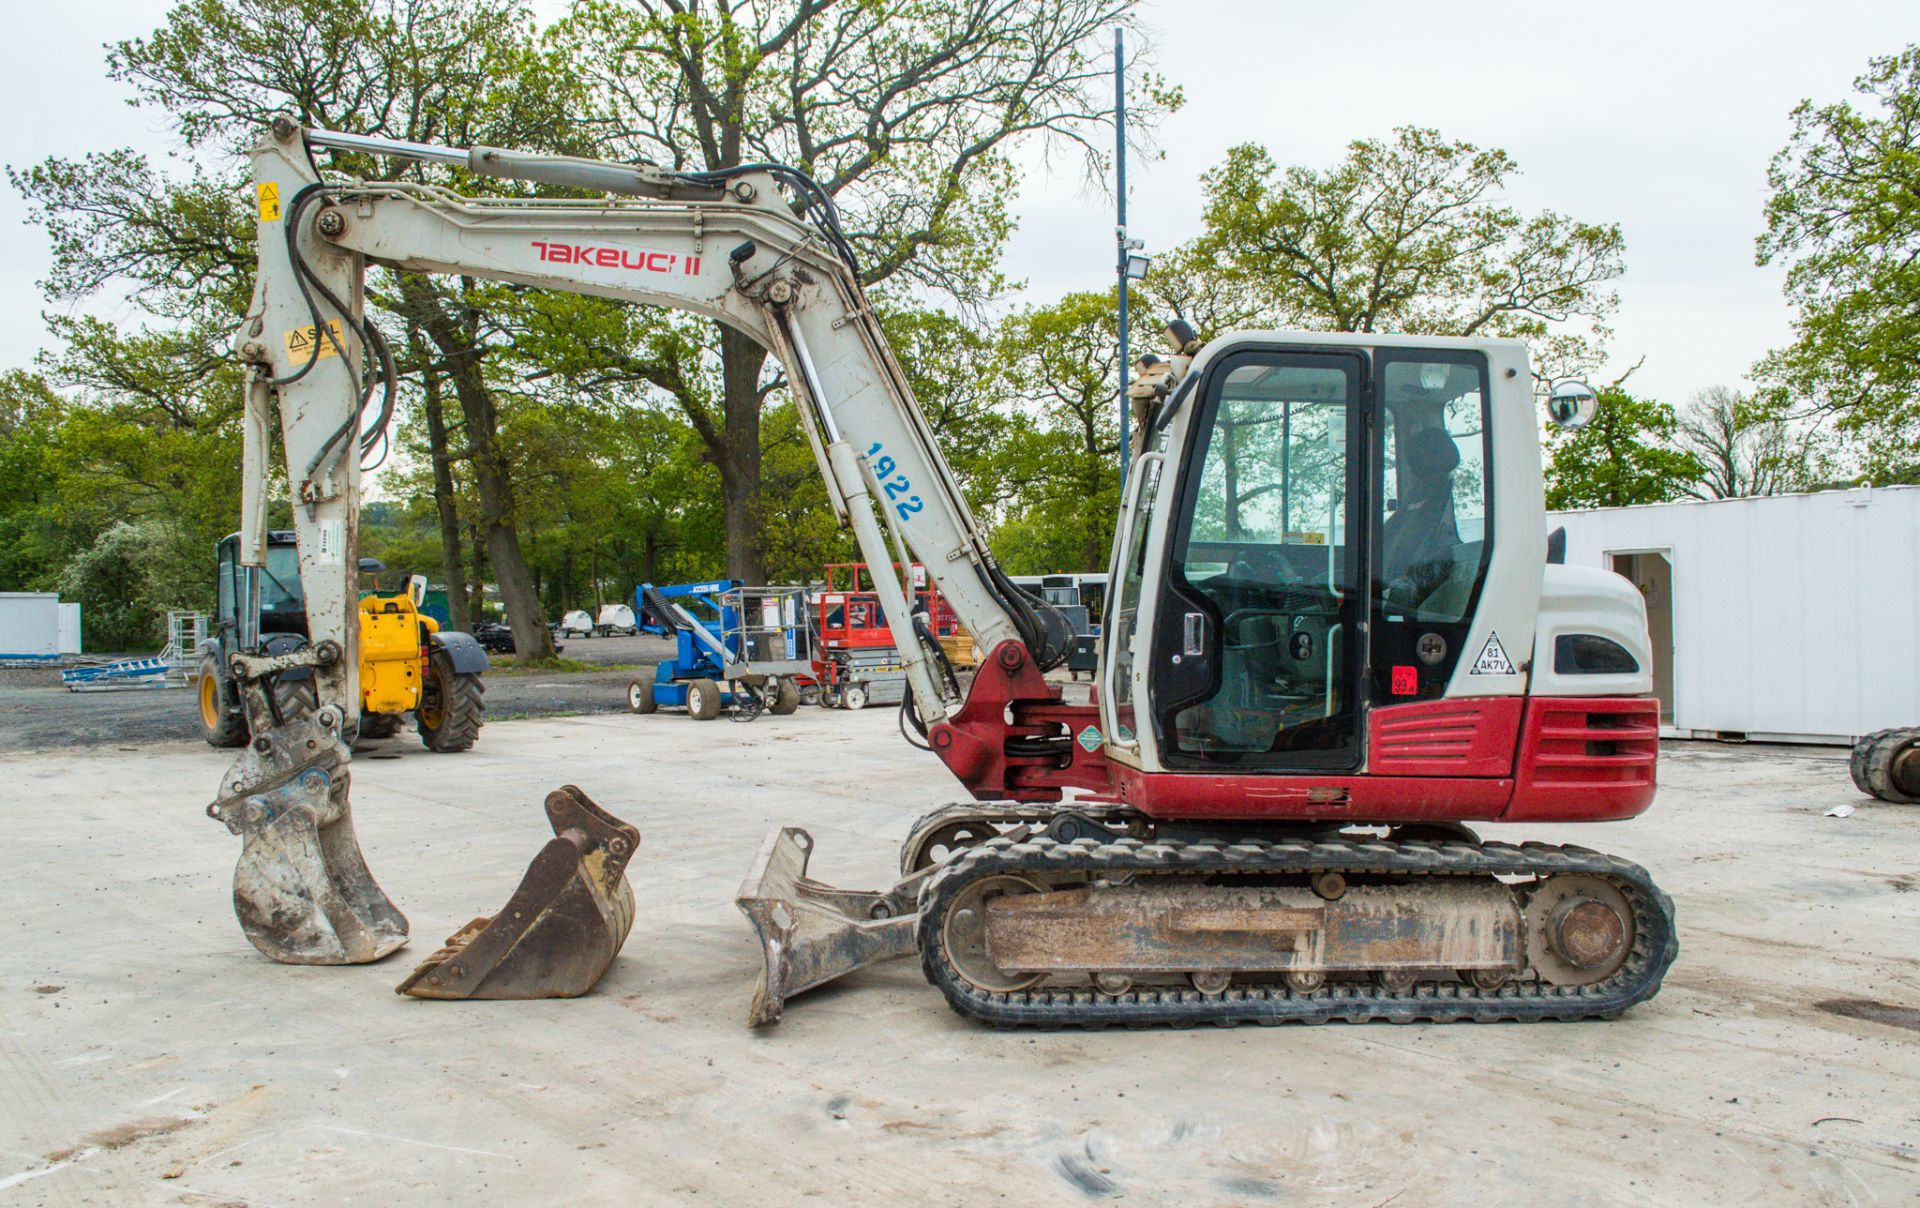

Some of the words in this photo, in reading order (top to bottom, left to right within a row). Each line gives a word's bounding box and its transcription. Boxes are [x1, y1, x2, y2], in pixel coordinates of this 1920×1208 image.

[867, 442, 924, 521] 1922
[1487, 647, 1499, 658] 81
[1480, 659, 1506, 670] AK7V
